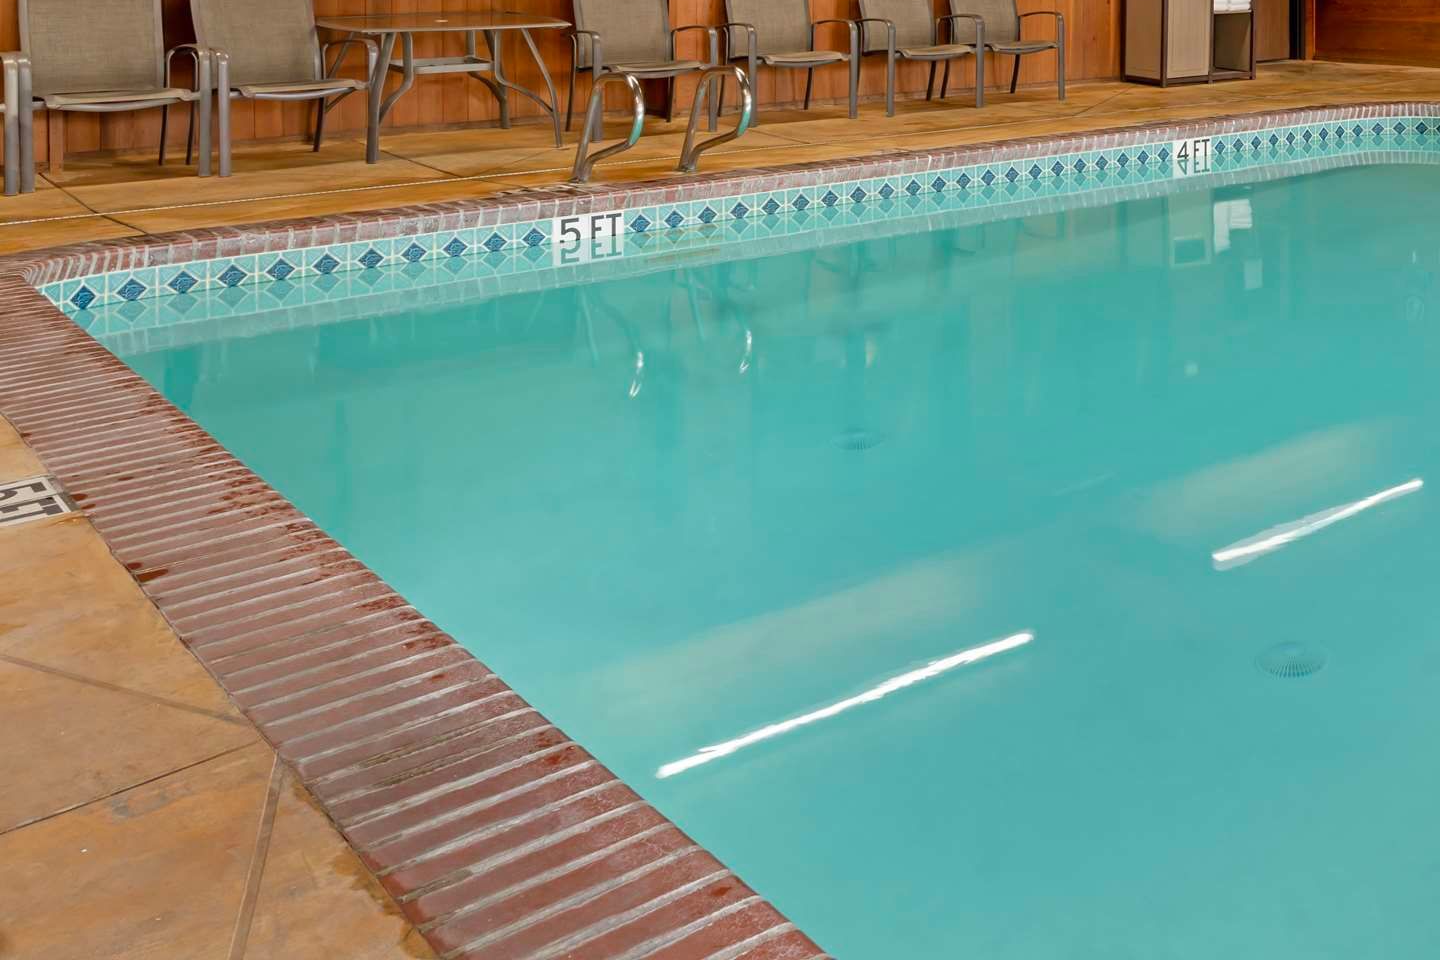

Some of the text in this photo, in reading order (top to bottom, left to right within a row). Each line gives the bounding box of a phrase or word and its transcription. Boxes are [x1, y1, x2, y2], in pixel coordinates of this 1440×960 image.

[1177, 139, 1210, 159] 4 FT
[560, 213, 622, 243] 5 FT
